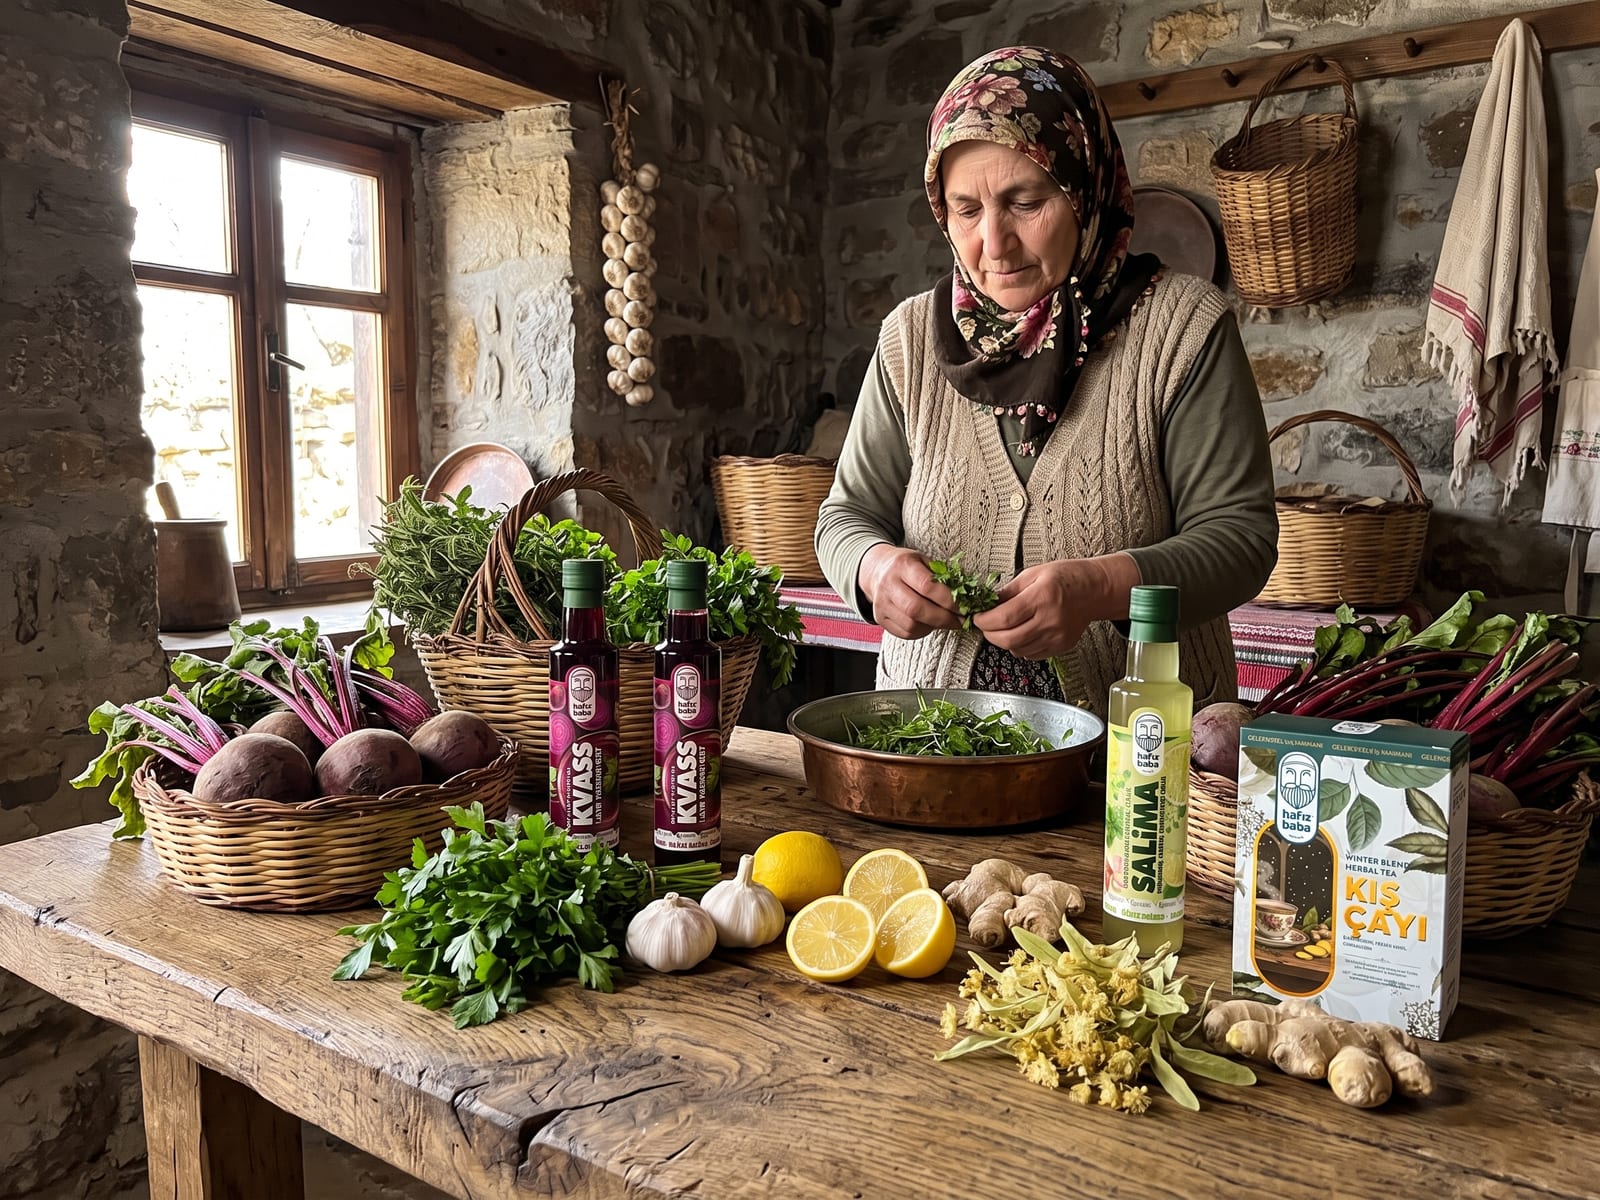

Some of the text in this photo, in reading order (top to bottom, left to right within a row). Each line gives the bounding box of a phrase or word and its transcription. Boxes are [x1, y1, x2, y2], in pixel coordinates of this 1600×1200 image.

[572, 741, 594, 826] KVASS
[677, 740, 698, 824] KVASS
[1282, 809, 1312, 822] hafız
[1282, 820, 1311, 832] baba
[1345, 854, 1409, 869] WINTER BLEND
[1345, 863, 1398, 878] HERBAL TEA
[1345, 875, 1401, 917] KIŞ
[1344, 904, 1428, 942] ÇAYI
